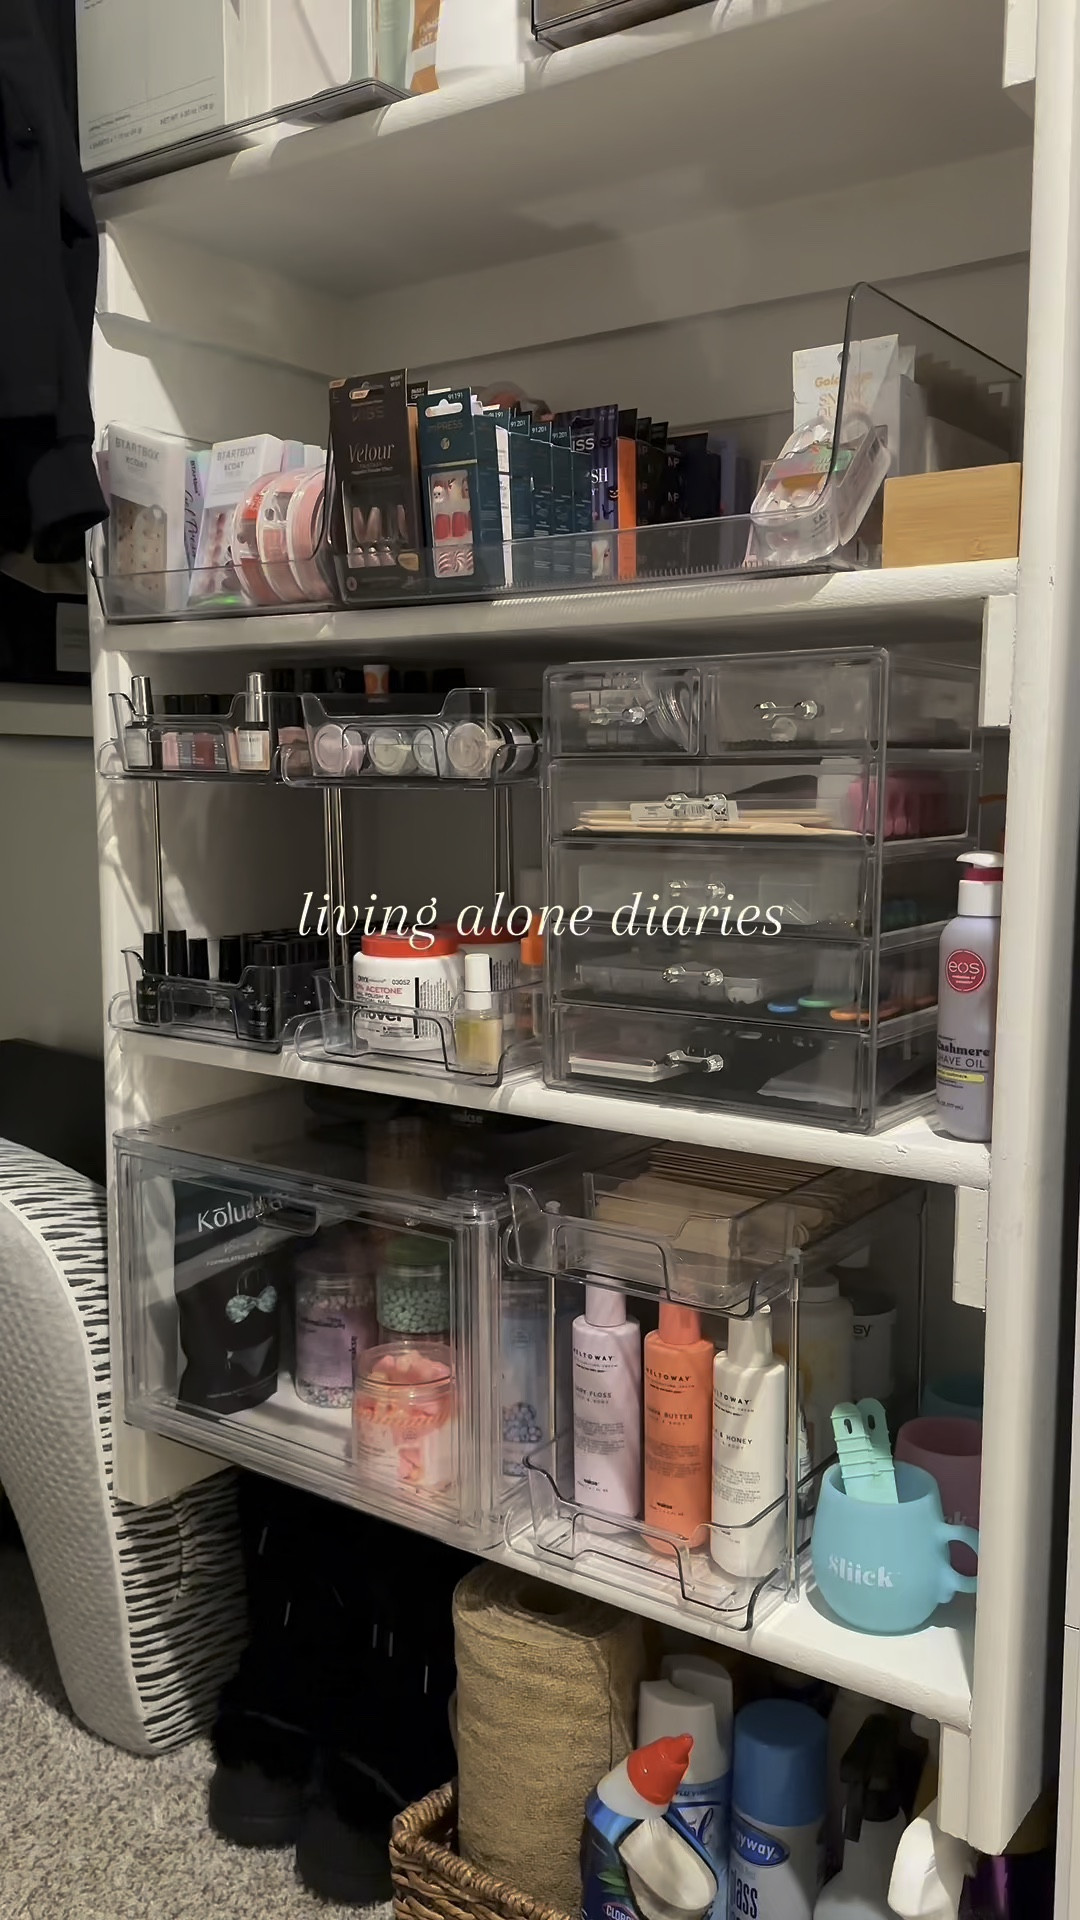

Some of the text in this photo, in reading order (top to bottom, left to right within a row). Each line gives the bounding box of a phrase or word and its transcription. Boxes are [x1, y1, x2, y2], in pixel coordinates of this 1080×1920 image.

[571, 437, 596, 454] ISS
[348, 442, 395, 463] Velour
[948, 961, 981, 974] eos
[365, 986, 403, 995] ACETONE
[965, 1058, 985, 1069] OIL
[589, 1390, 612, 1399] FLOSS
[664, 1411, 693, 1420] BUTTER
[726, 1434, 753, 1445] HONEY
